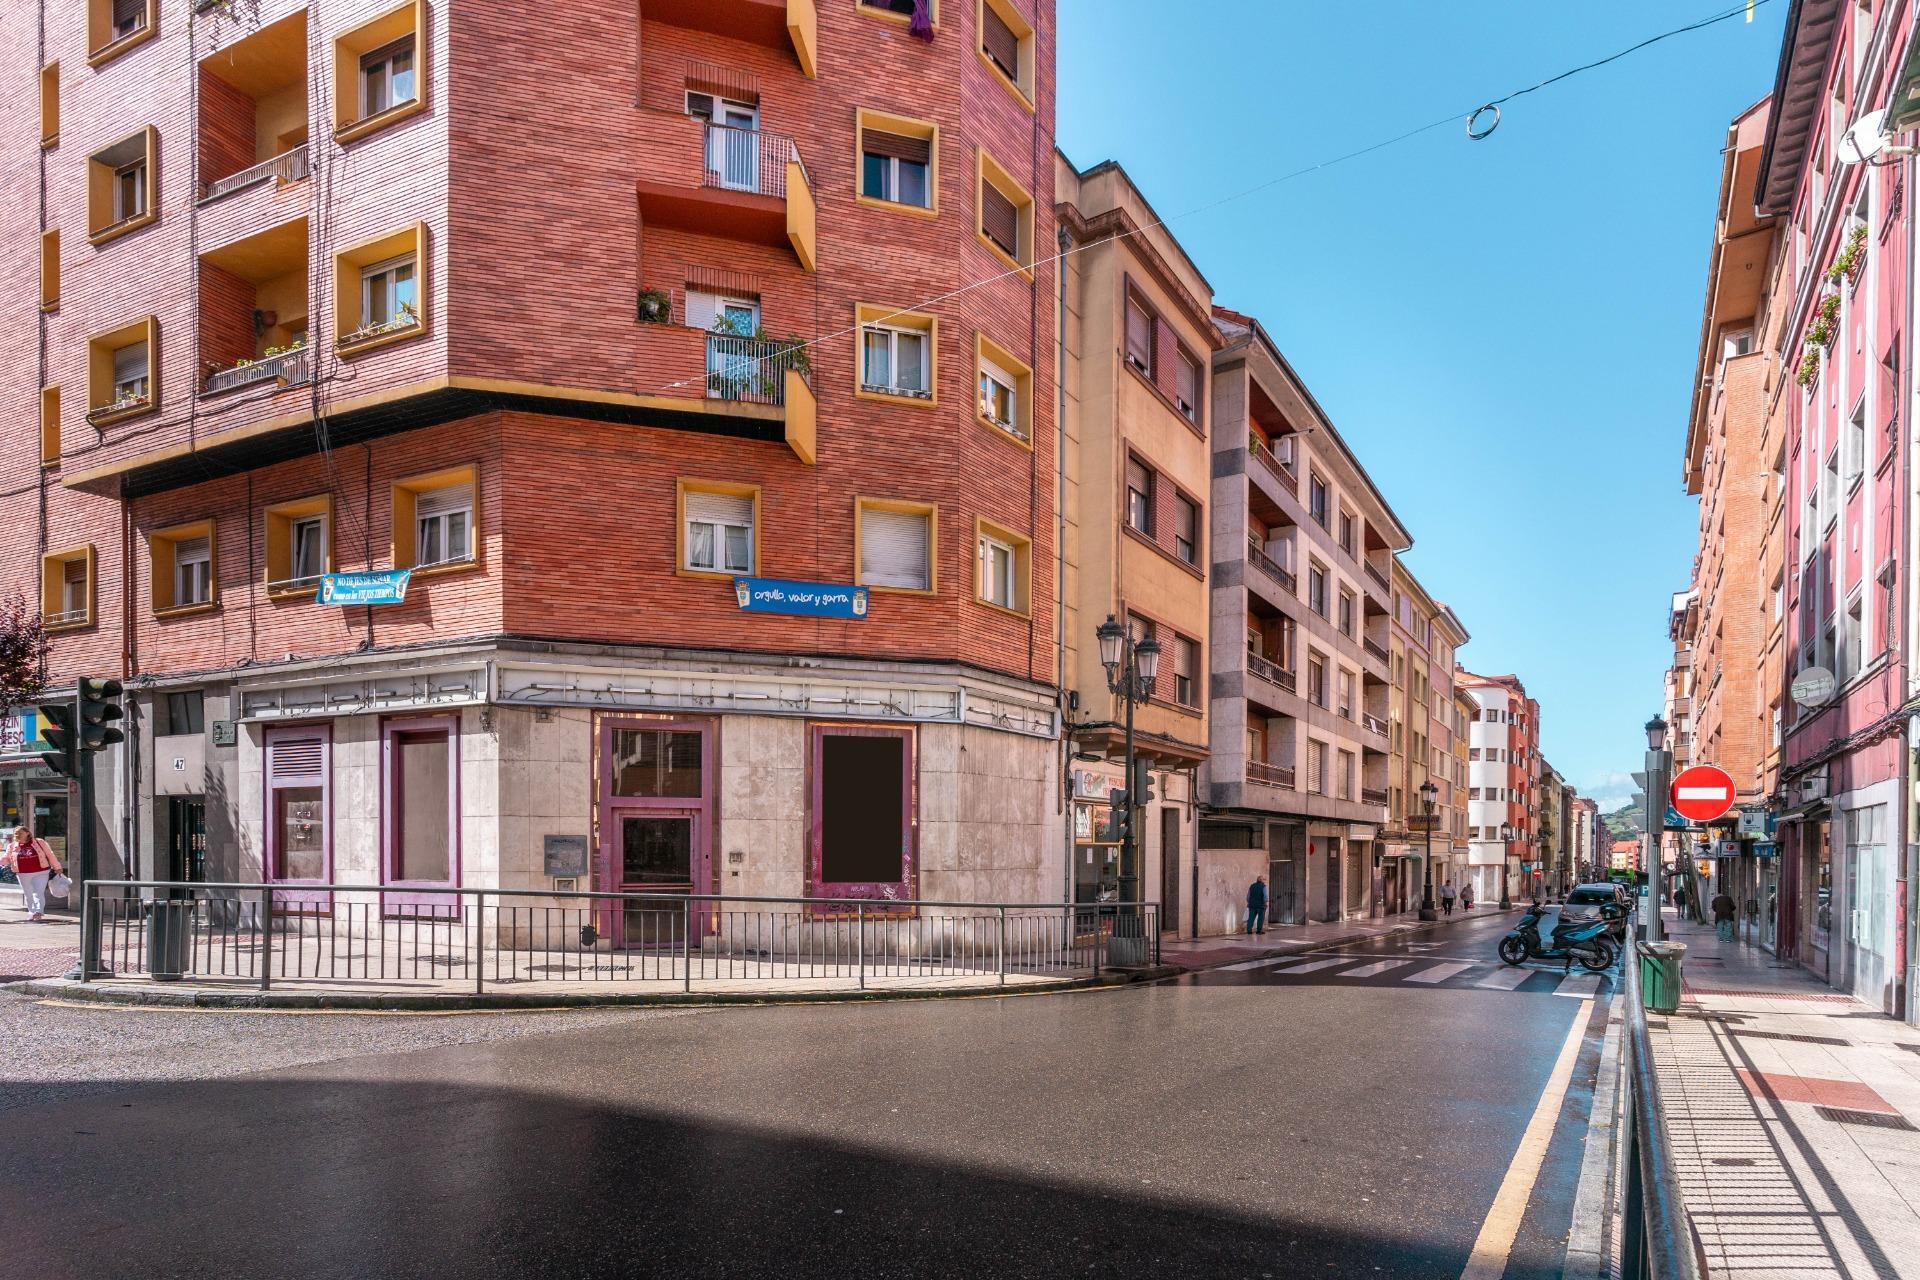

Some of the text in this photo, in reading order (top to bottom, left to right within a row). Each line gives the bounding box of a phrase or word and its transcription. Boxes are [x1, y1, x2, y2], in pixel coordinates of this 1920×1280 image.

[337, 578, 346, 586] NO
[364, 576, 371, 585] DE
[358, 589, 374, 601] VIEJOS
[754, 589, 849, 606] orgullo, valor y garra
[175, 760, 184, 770] 47
